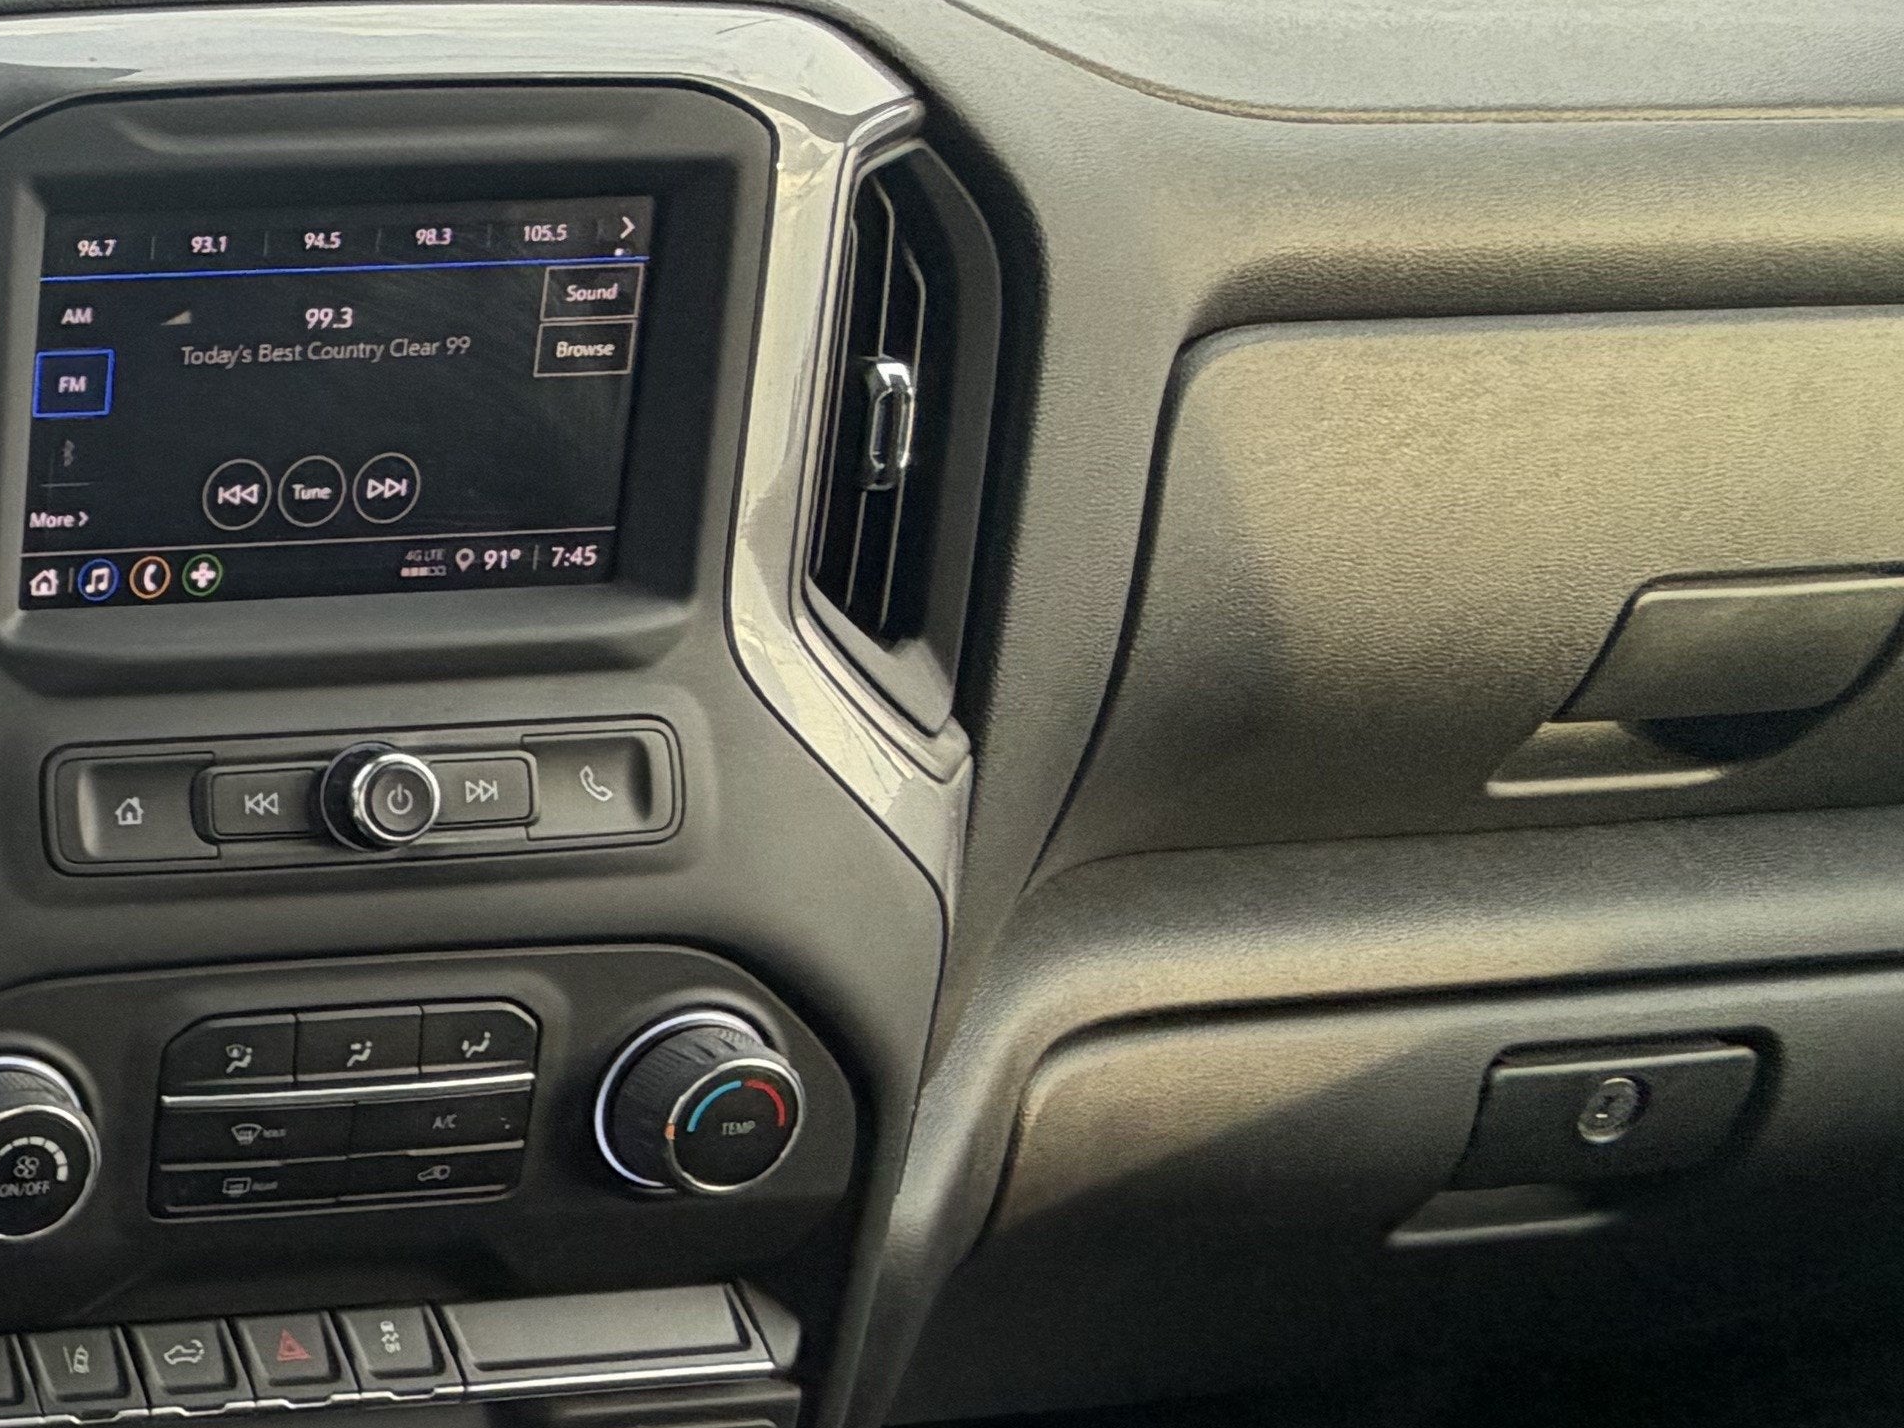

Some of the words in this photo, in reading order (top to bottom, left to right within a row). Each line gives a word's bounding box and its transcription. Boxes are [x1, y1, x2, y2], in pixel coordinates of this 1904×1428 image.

[303, 231, 341, 250] 94.5
[415, 227, 452, 246] 98.3
[522, 223, 568, 243] 105.5
[77, 239, 116, 259] 96.7
[190, 235, 227, 255] 93.1
[565, 283, 618, 302] Sound
[61, 307, 94, 325] AM
[304, 308, 354, 330] 99.3
[180, 344, 252, 368] Today's
[257, 342, 302, 363] Best
[307, 339, 385, 365] Country
[390, 337, 441, 357] Clear
[445, 336, 472, 355] 99
[555, 340, 616, 359] Browse
[58, 376, 87, 393] FM
[292, 483, 332, 500] Tune
[29, 511, 75, 528] More
[551, 544, 598, 568] 7:45
